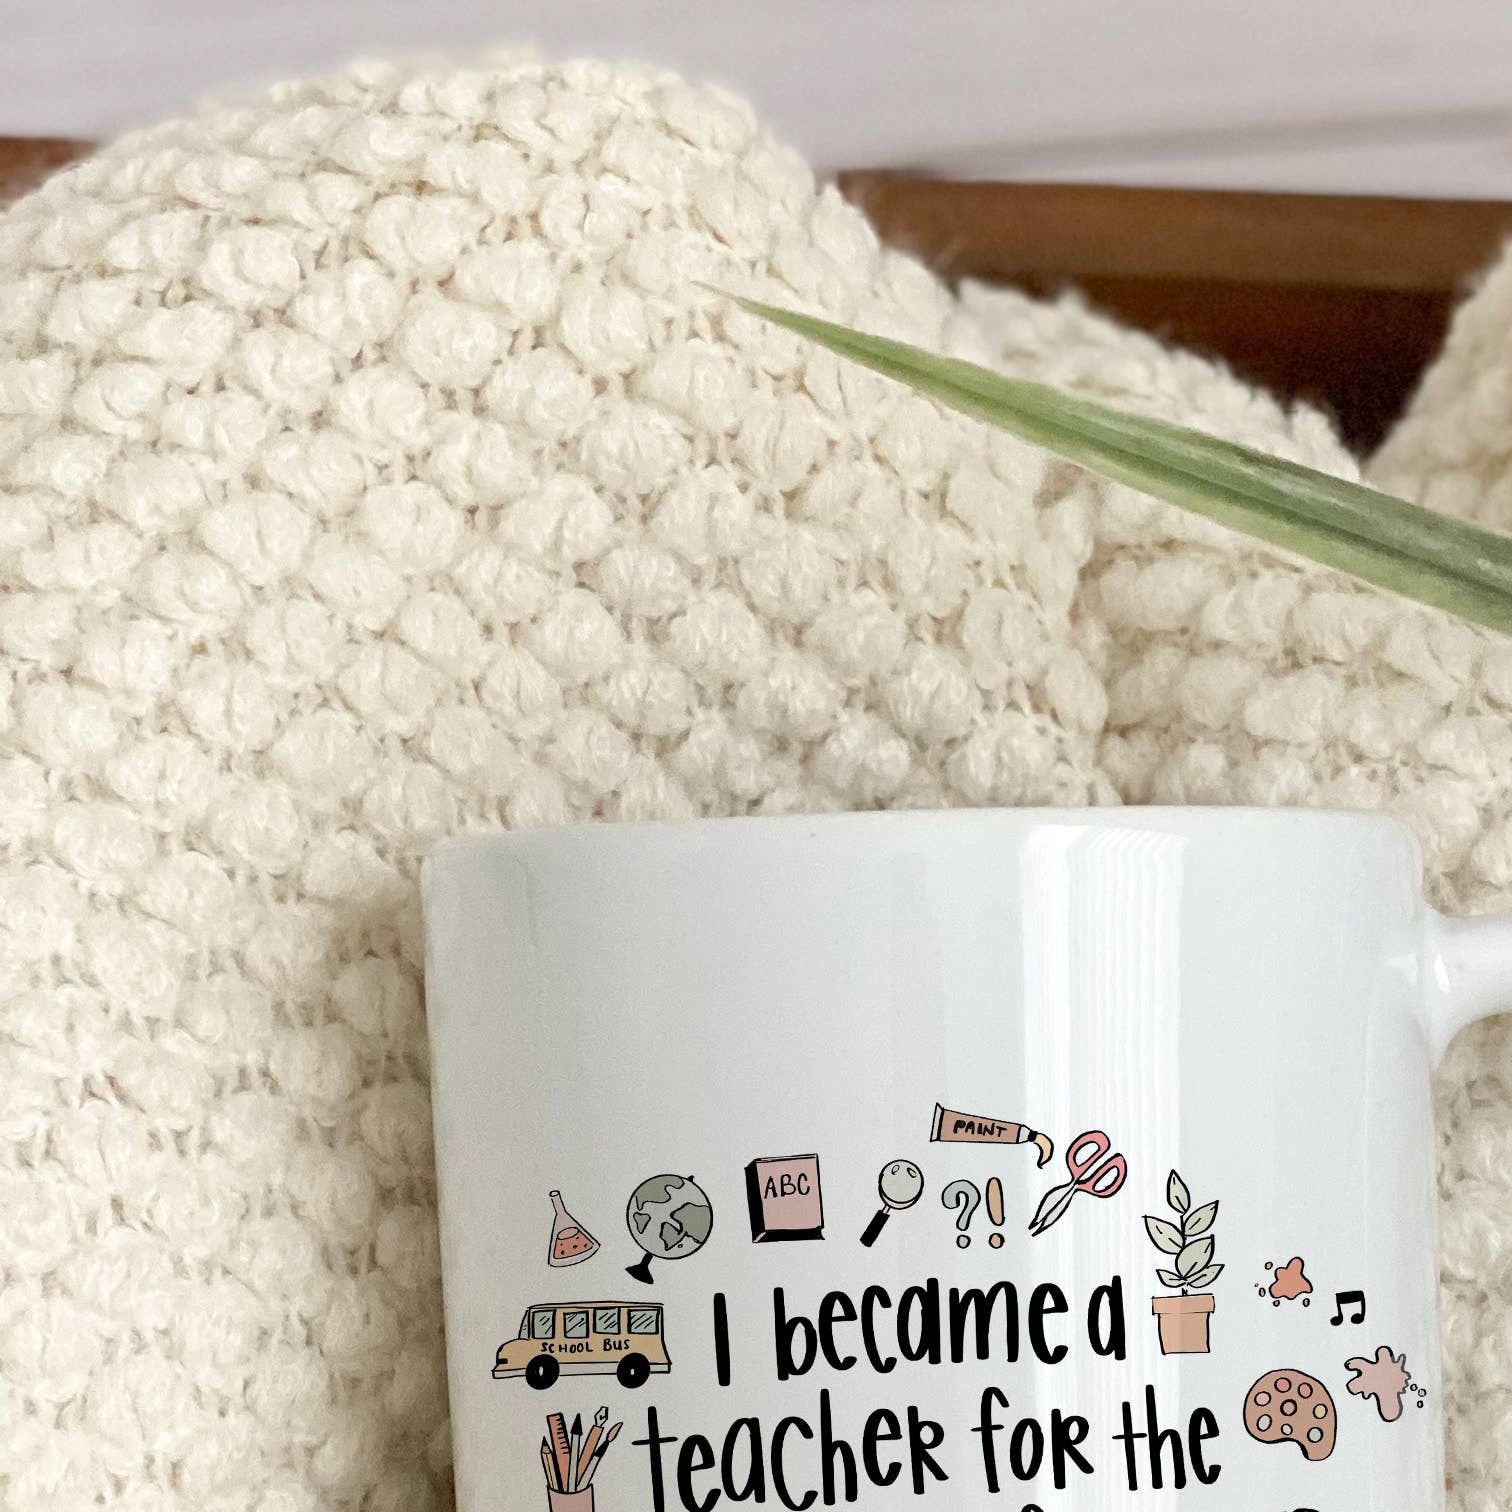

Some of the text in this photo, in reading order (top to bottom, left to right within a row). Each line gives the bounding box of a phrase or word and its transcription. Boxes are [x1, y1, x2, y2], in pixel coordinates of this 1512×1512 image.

[952, 1118, 1008, 1138] PAINT
[763, 1172, 812, 1200] ABC
[713, 1275, 1126, 1387] I became a
[540, 1337, 631, 1354] SCHOOL BUS
[1111, 1384, 1222, 1491] the
